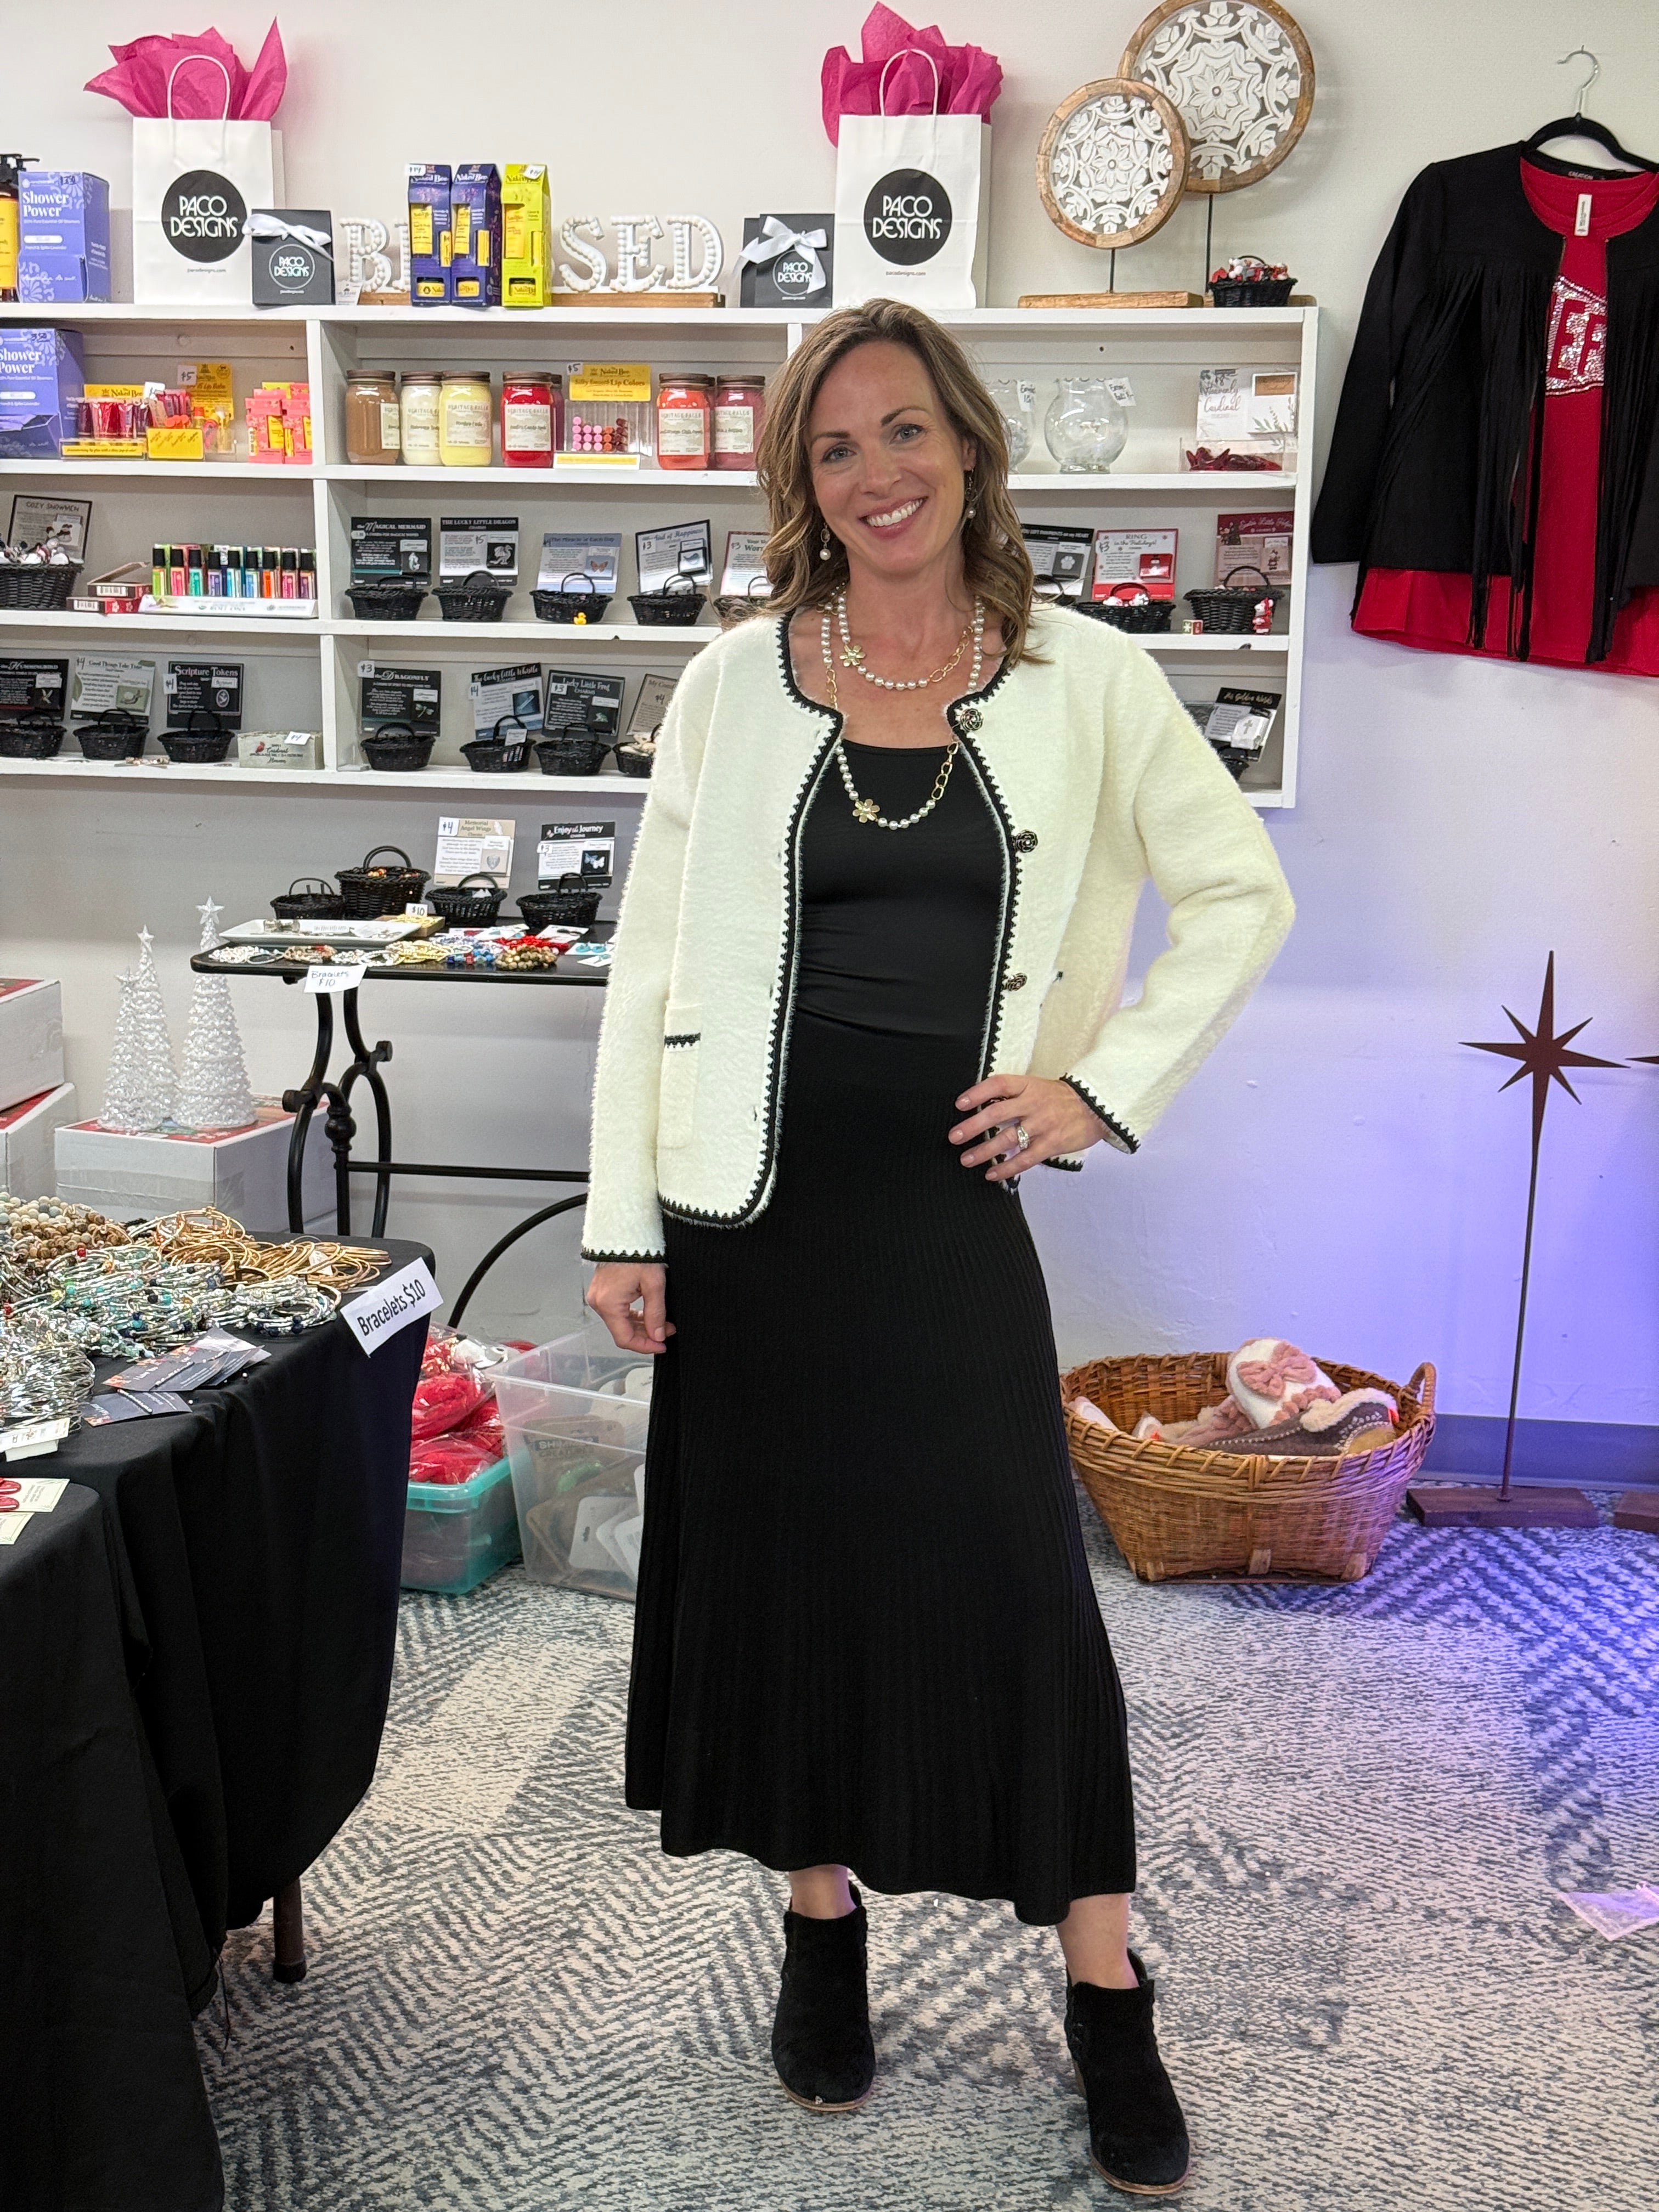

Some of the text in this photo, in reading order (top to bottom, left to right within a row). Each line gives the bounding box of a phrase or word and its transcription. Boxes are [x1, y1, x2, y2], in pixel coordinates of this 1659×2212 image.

[22, 192, 69, 205] Shower
[23, 205, 62, 217] Power
[179, 195, 227, 217] PACO
[882, 195, 933, 217] PACO
[170, 217, 238, 238] DESIGNS
[872, 218, 943, 239] DESIGNS
[279, 257, 304, 267] PACO
[782, 262, 808, 273] PACO
[274, 266, 309, 277] DESIGNS
[0, 349, 42, 361] Shower
[0, 363, 35, 374] Power
[568, 363, 580, 373] $5
[610, 379, 622, 387] Lip
[1204, 396, 1241, 413] Cardinal
[47, 503, 80, 511] SNOWMEN
[174, 665, 238, 677] Scripture Tokens
[360, 664, 373, 673] $3
[381, 670, 430, 681] DRAGONFLY
[483, 672, 500, 682] Lucky
[500, 668, 516, 678] Little
[554, 685, 566, 693] $3
[580, 680, 596, 689] Little
[597, 681, 610, 692] Frog
[442, 822, 453, 833] $4
[554, 826, 571, 835] Enjoy
[578, 825, 604, 833] Journey
[412, 906, 425, 916] $10
[318, 978, 336, 986] $10
[357, 1278, 427, 1337] Bracelets $10
